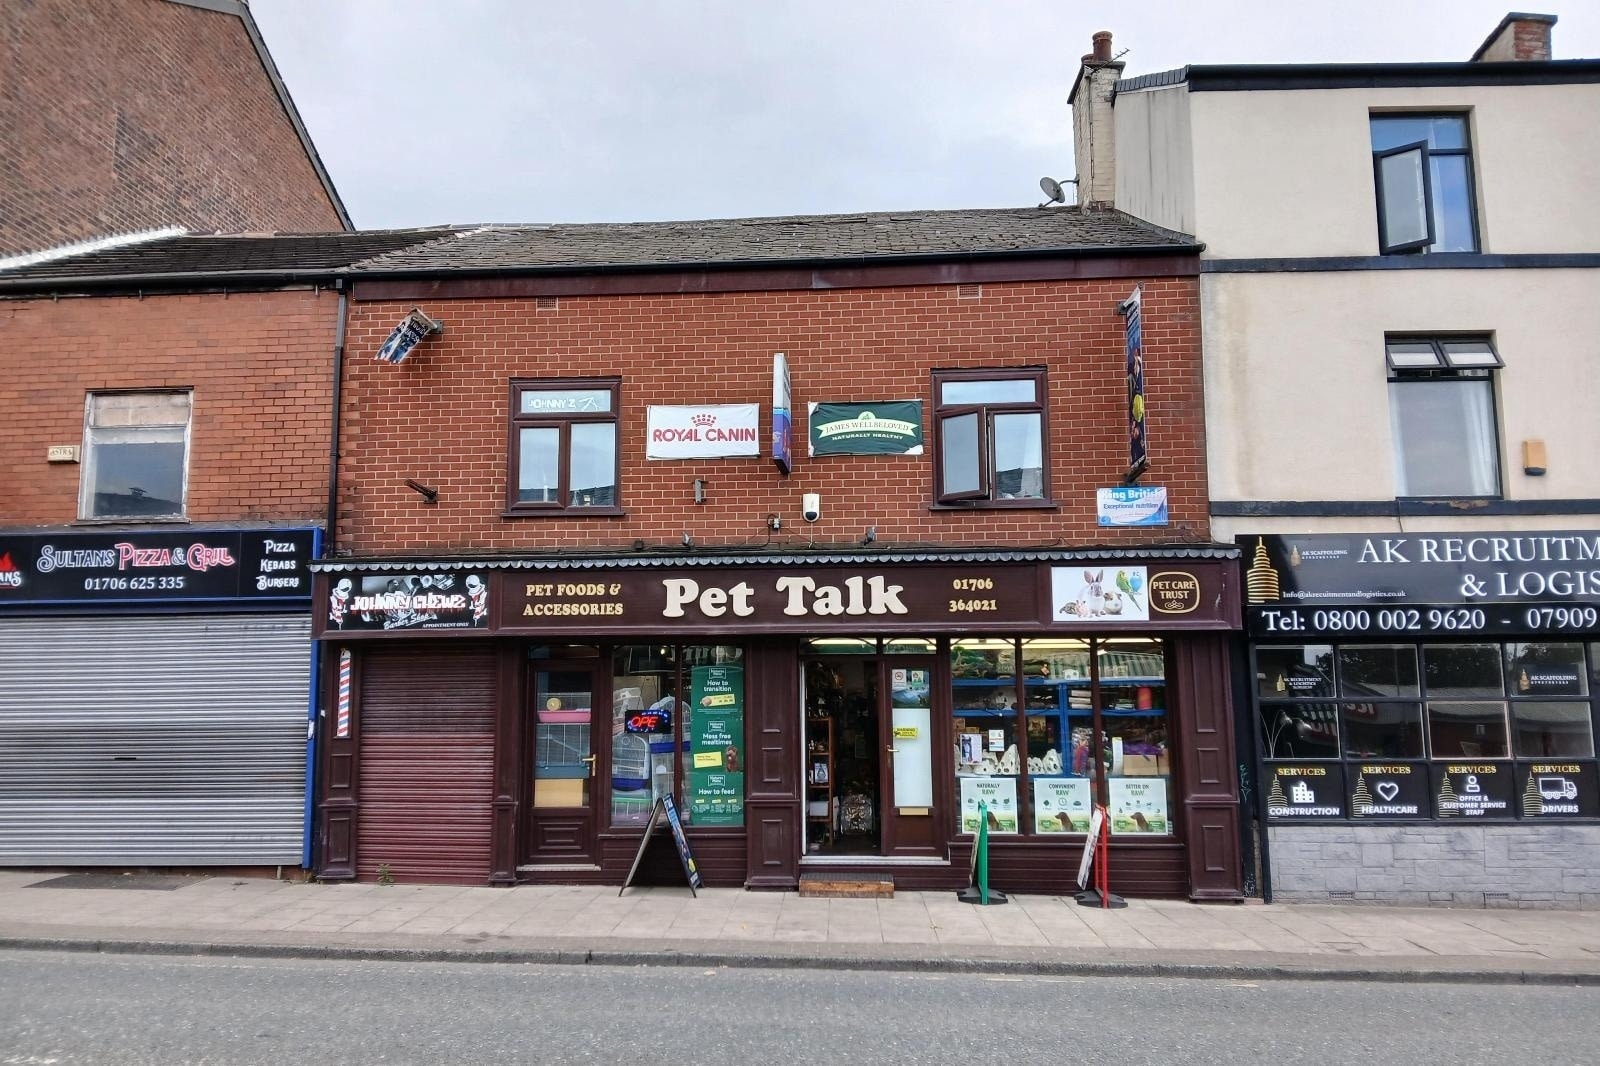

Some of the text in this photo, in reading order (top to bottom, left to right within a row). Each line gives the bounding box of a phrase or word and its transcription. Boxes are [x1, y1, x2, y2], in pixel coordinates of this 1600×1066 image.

[825, 421, 909, 433] JAMES WELLBELOVED
[653, 428, 755, 442] ROYAL CANIN
[1357, 536, 1600, 563] AK RECRUITM
[171, 547, 186, 566] &
[84, 576, 184, 590] 01706 625 335
[953, 578, 993, 590] 01706
[1152, 581, 1195, 590] PET CARE
[1460, 571, 1600, 597] & LOGIS
[526, 583, 621, 596] PET FOODS &
[1160, 591, 1189, 599] TRUST
[350, 591, 411, 610] JOHNNY
[662, 575, 908, 617] Pet Talk
[523, 603, 624, 616] ACCESSORIES
[949, 599, 997, 612] 364021
[1261, 610, 1305, 632] Tel:
[1313, 610, 1370, 631] 0800
[1378, 610, 1421, 630] 002
[1429, 609, 1486, 630] 9620
[1527, 608, 1597, 630] 07909
[1278, 768, 1326, 776] SERVICES
[1362, 766, 1411, 774] SERVICES
[1448, 765, 1497, 774] SERVICES
[1532, 765, 1581, 773] SERVICES
[1268, 807, 1340, 816] CONSTRUCTION
[1361, 805, 1418, 814] HEALTHCARE
[1541, 805, 1579, 813] DRIVERS
